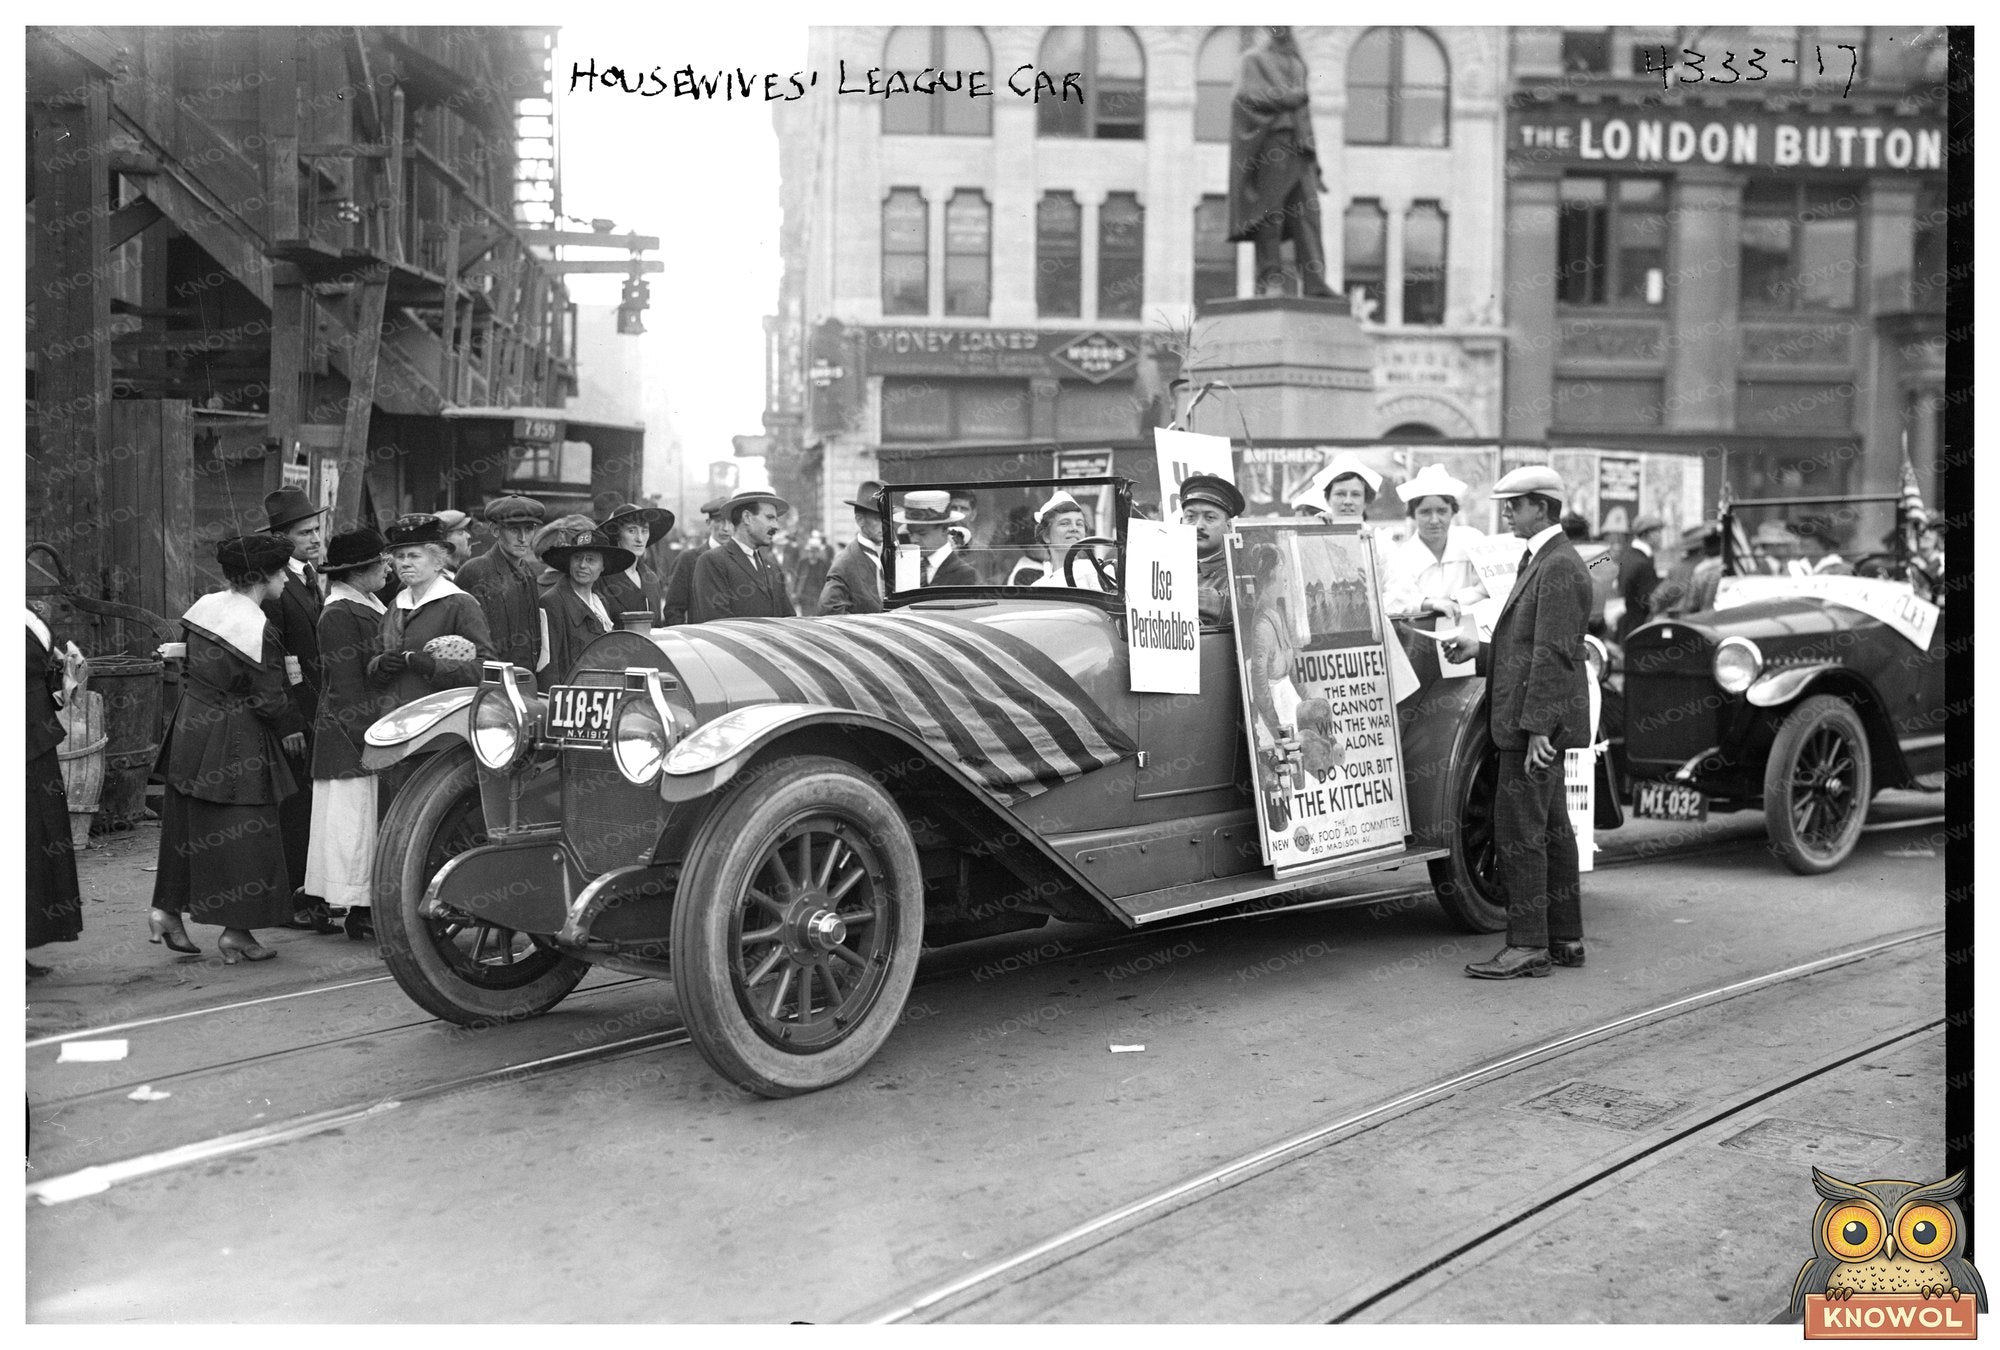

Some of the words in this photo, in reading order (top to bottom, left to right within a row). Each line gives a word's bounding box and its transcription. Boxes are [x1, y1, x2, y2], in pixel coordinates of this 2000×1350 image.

[1520, 125, 1570, 148] THE
[1579, 117, 1758, 164] LONDON
[1774, 124, 1942, 169] BUTTON
[877, 330, 954, 353] MONEY
[1151, 560, 1173, 601] Use
[1131, 608, 1195, 651] Perishables
[1295, 650, 1386, 684] HOUSEWIFE!
[1324, 685, 1346, 699] THE
[1350, 682, 1377, 697] MEN
[1332, 697, 1384, 716] CANNOT
[1316, 719, 1343, 736] WIN
[1345, 716, 1366, 732] THE
[1367, 713, 1392, 730] WAR
[1345, 732, 1384, 751] ALONE
[1317, 766, 1337, 784] DO
[1340, 762, 1375, 780] YOUR
[1376, 757, 1394, 774] BIT
[1294, 790, 1326, 818] THE
[1329, 777, 1394, 813] KITCHEN
[1272, 838, 1290, 852] NEW
[1293, 832, 1316, 848] YORK
[1318, 827, 1341, 843] FOOD
[1344, 825, 1358, 837] AID
[1361, 816, 1400, 833] COMMITTEE
[1334, 819, 1346, 827] THE
[1326, 838, 1360, 851] MADISON
